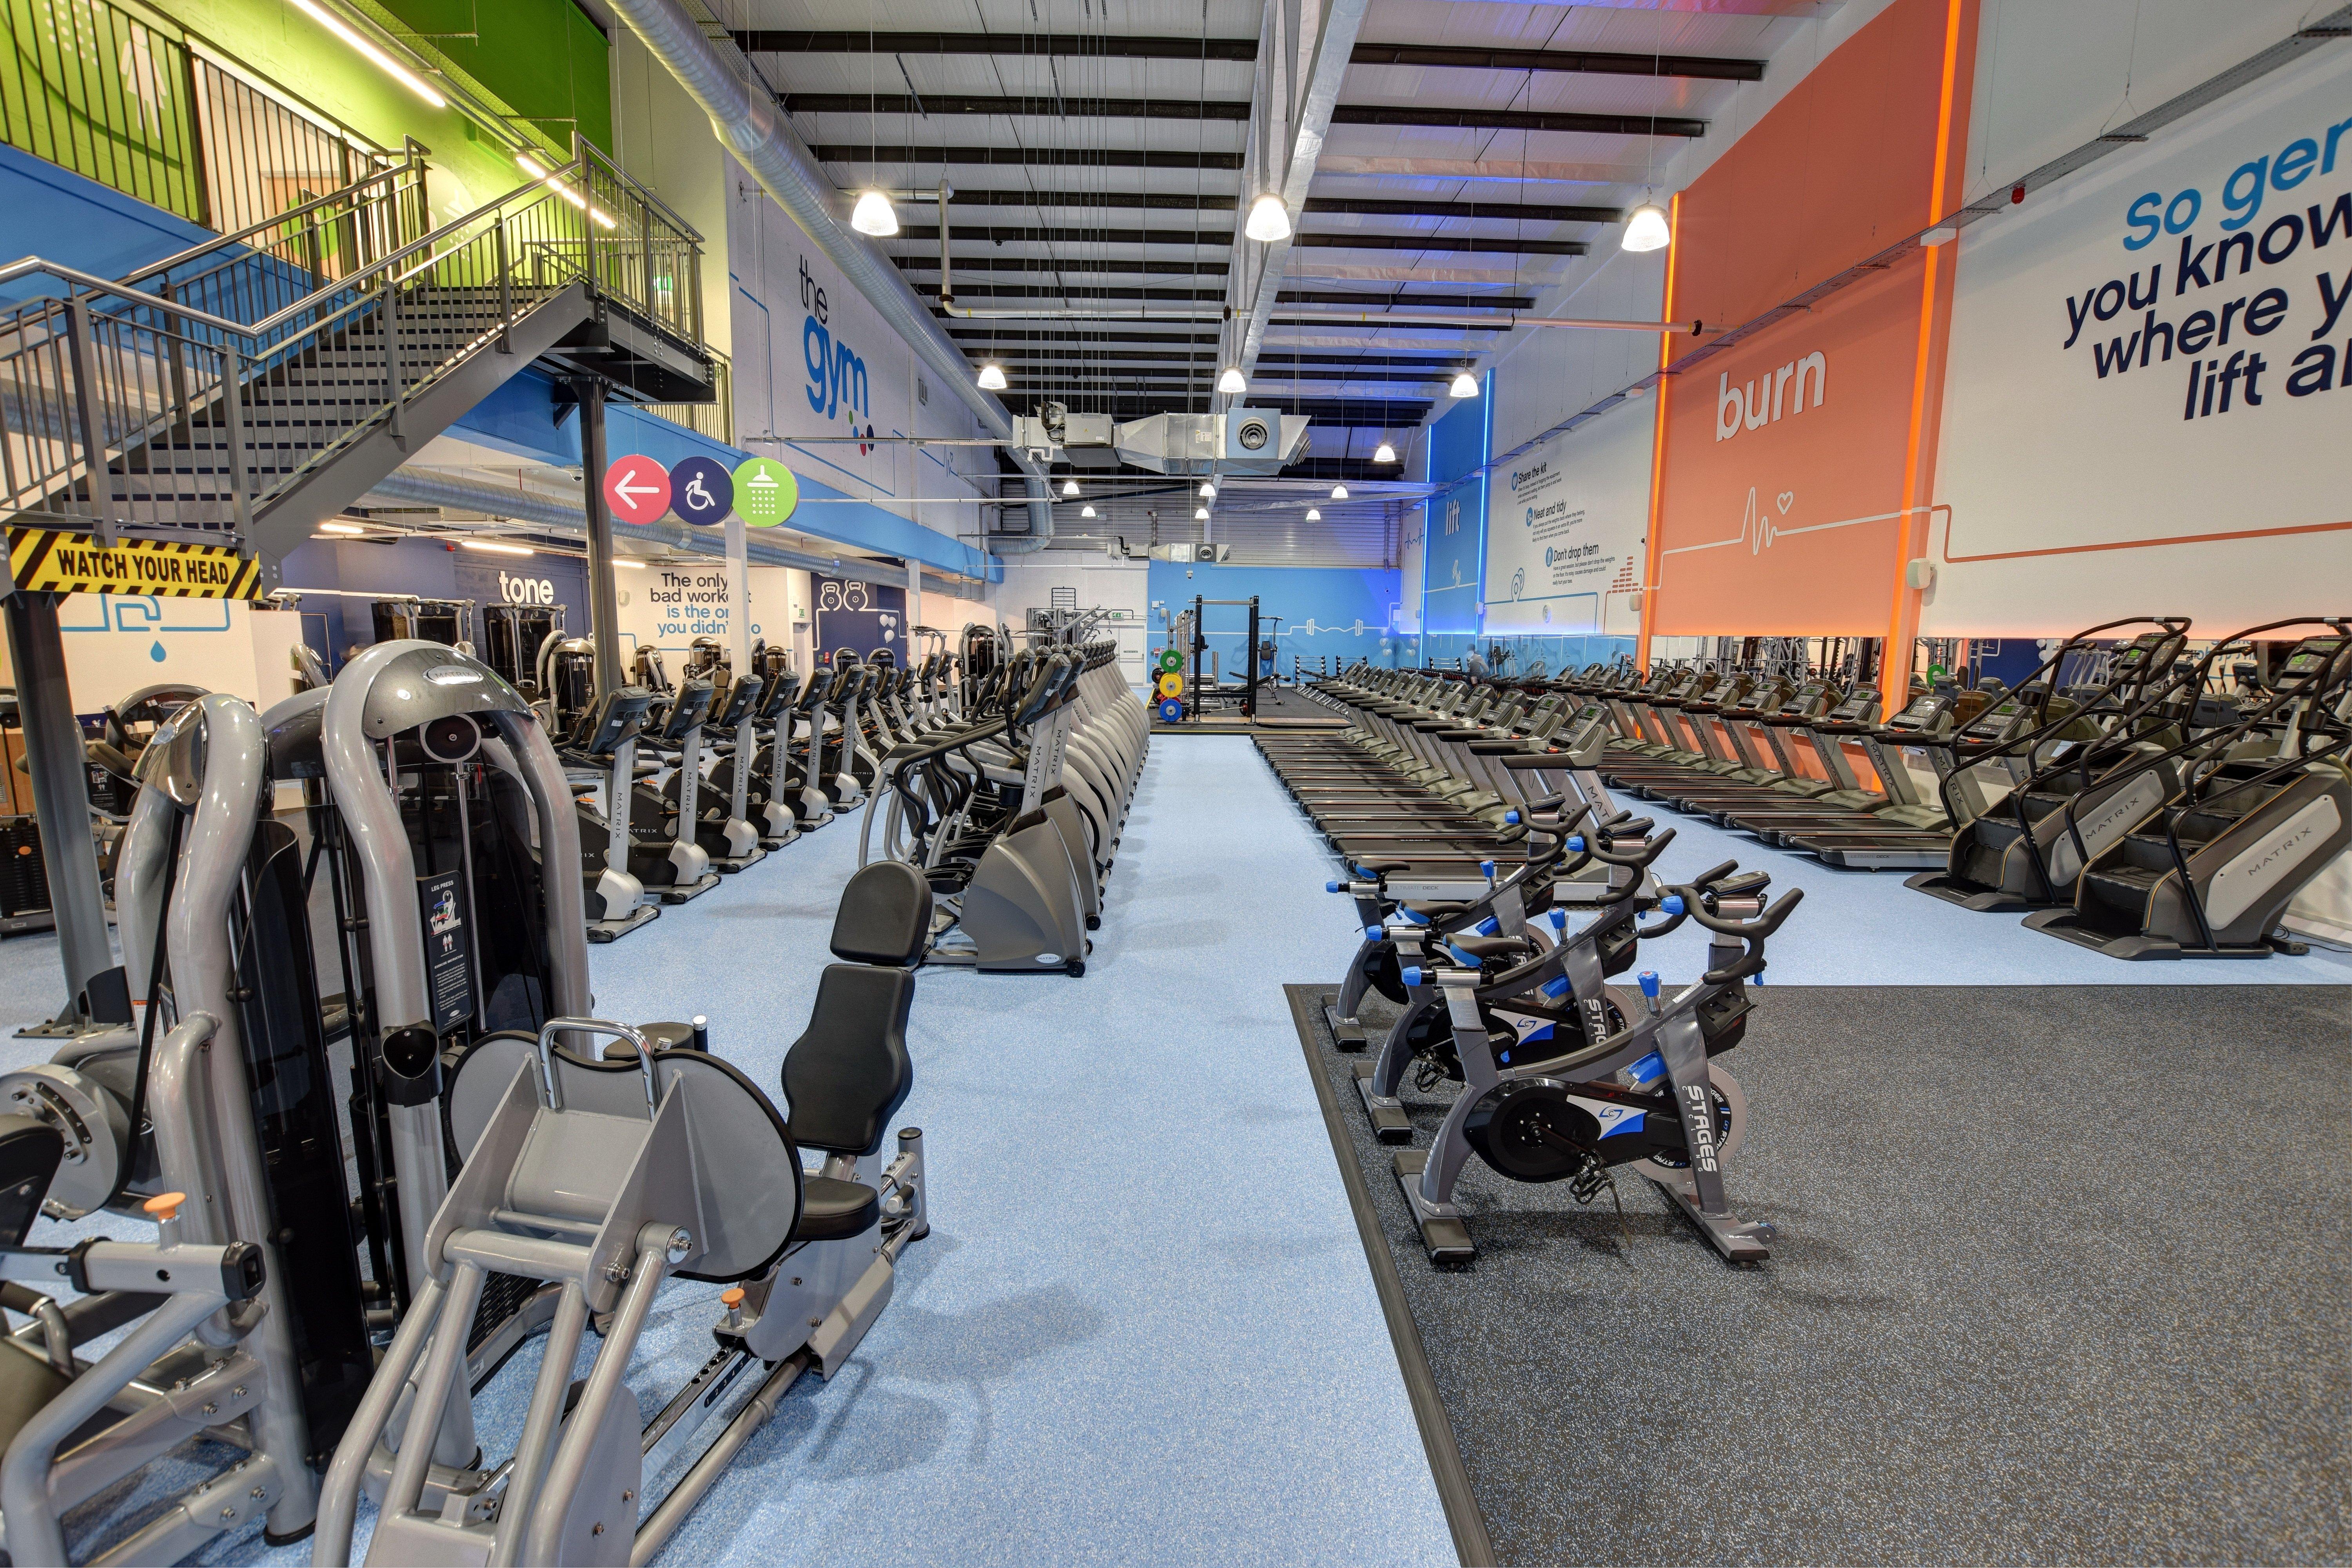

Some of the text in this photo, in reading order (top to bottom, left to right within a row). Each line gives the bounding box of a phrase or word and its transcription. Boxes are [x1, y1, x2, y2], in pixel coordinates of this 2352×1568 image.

[2123, 189, 2201, 251] So
[799, 254, 828, 325] the
[2063, 192, 2352, 350] you know
[2093, 288, 2288, 379] where
[804, 315, 869, 420] gym
[2183, 338, 2352, 421] lift a
[1715, 350, 1828, 443] burn
[1519, 471, 1531, 484] Share
[1445, 498, 1461, 536] lift
[1534, 499, 1566, 520] Neat and tidy
[56, 549, 229, 585] WATCH YOUR HEAD
[1554, 543, 1599, 562] Don't drop them
[498, 571, 554, 604] tone
[650, 588, 682, 603] bad
[661, 572, 728, 591] The only
[657, 622, 686, 638] you
[691, 619, 730, 634] didn'
[667, 604, 680, 618] is
[684, 604, 710, 618] the
[874, 711, 886, 734] MATRIX
[1051, 730, 1062, 775] MATRIX
[1871, 745, 1895, 789] MATRIX
[1030, 746, 1042, 798] MATRIX
[1588, 786, 1610, 818] MAT
[2085, 797, 2140, 840] MATRIX
[2248, 826, 2312, 876] MATRIX
[440, 880, 454, 889] PRESS
[1532, 942, 1544, 954] STAG
[1587, 998, 1608, 1045] STAG
[1686, 1085, 1717, 1173] STAGES
[1653, 1155, 1675, 1167] STAG
